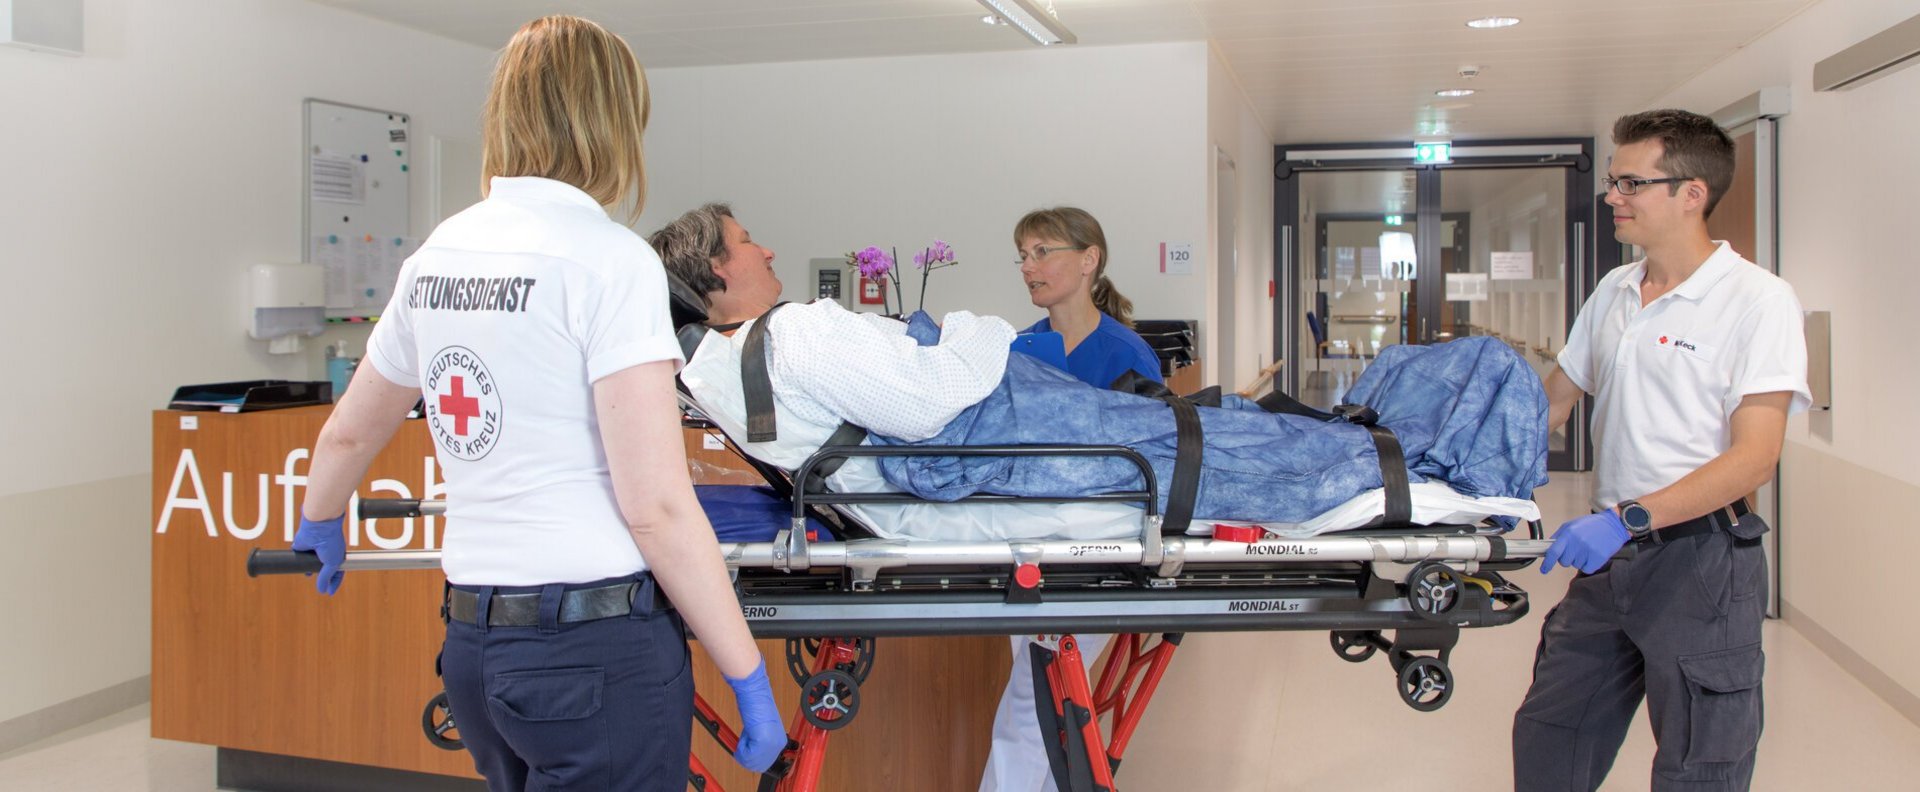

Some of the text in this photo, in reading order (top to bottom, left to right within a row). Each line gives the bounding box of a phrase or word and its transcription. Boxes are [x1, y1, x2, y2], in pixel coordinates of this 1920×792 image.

[1170, 250, 1190, 261] 120
[409, 275, 536, 313] ETTUNGSDIENST
[428, 352, 492, 397] DEUTSCHES
[429, 404, 497, 456] ROTES KREUZ
[156, 448, 447, 550] Aufah
[1245, 544, 1305, 555] MONDIAL
[742, 606, 777, 618] ERNO
[1228, 601, 1287, 612] MONDIAL
